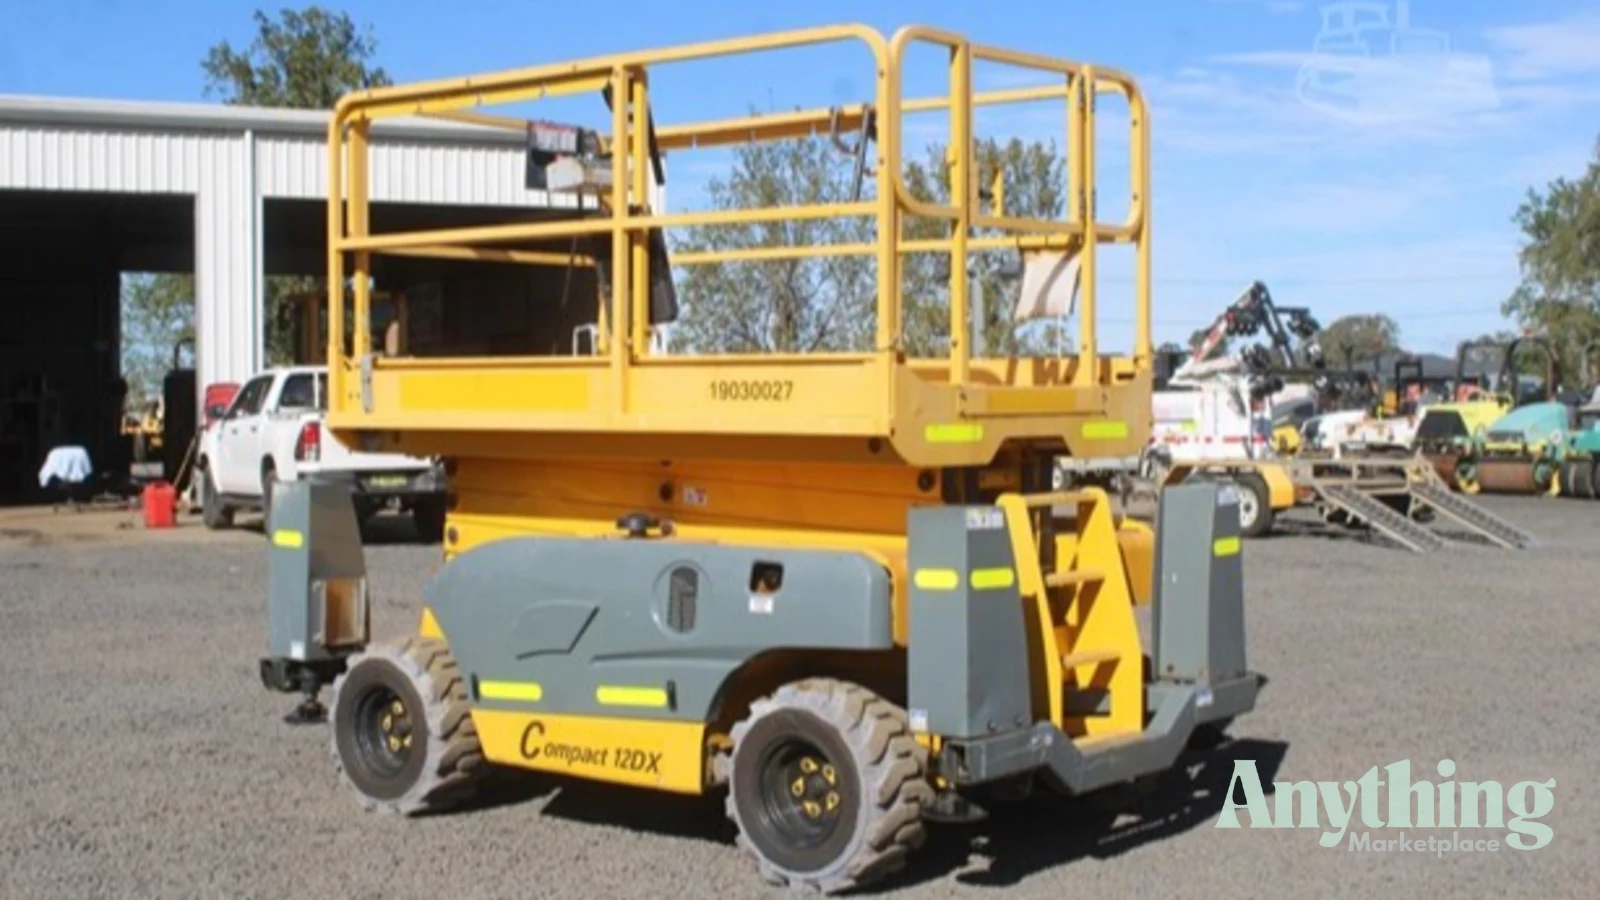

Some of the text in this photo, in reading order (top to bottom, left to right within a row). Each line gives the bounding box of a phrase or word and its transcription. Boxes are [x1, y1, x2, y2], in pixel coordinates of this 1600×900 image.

[709, 380, 793, 401] 19030027
[520, 720, 662, 774] Compact 12DX
